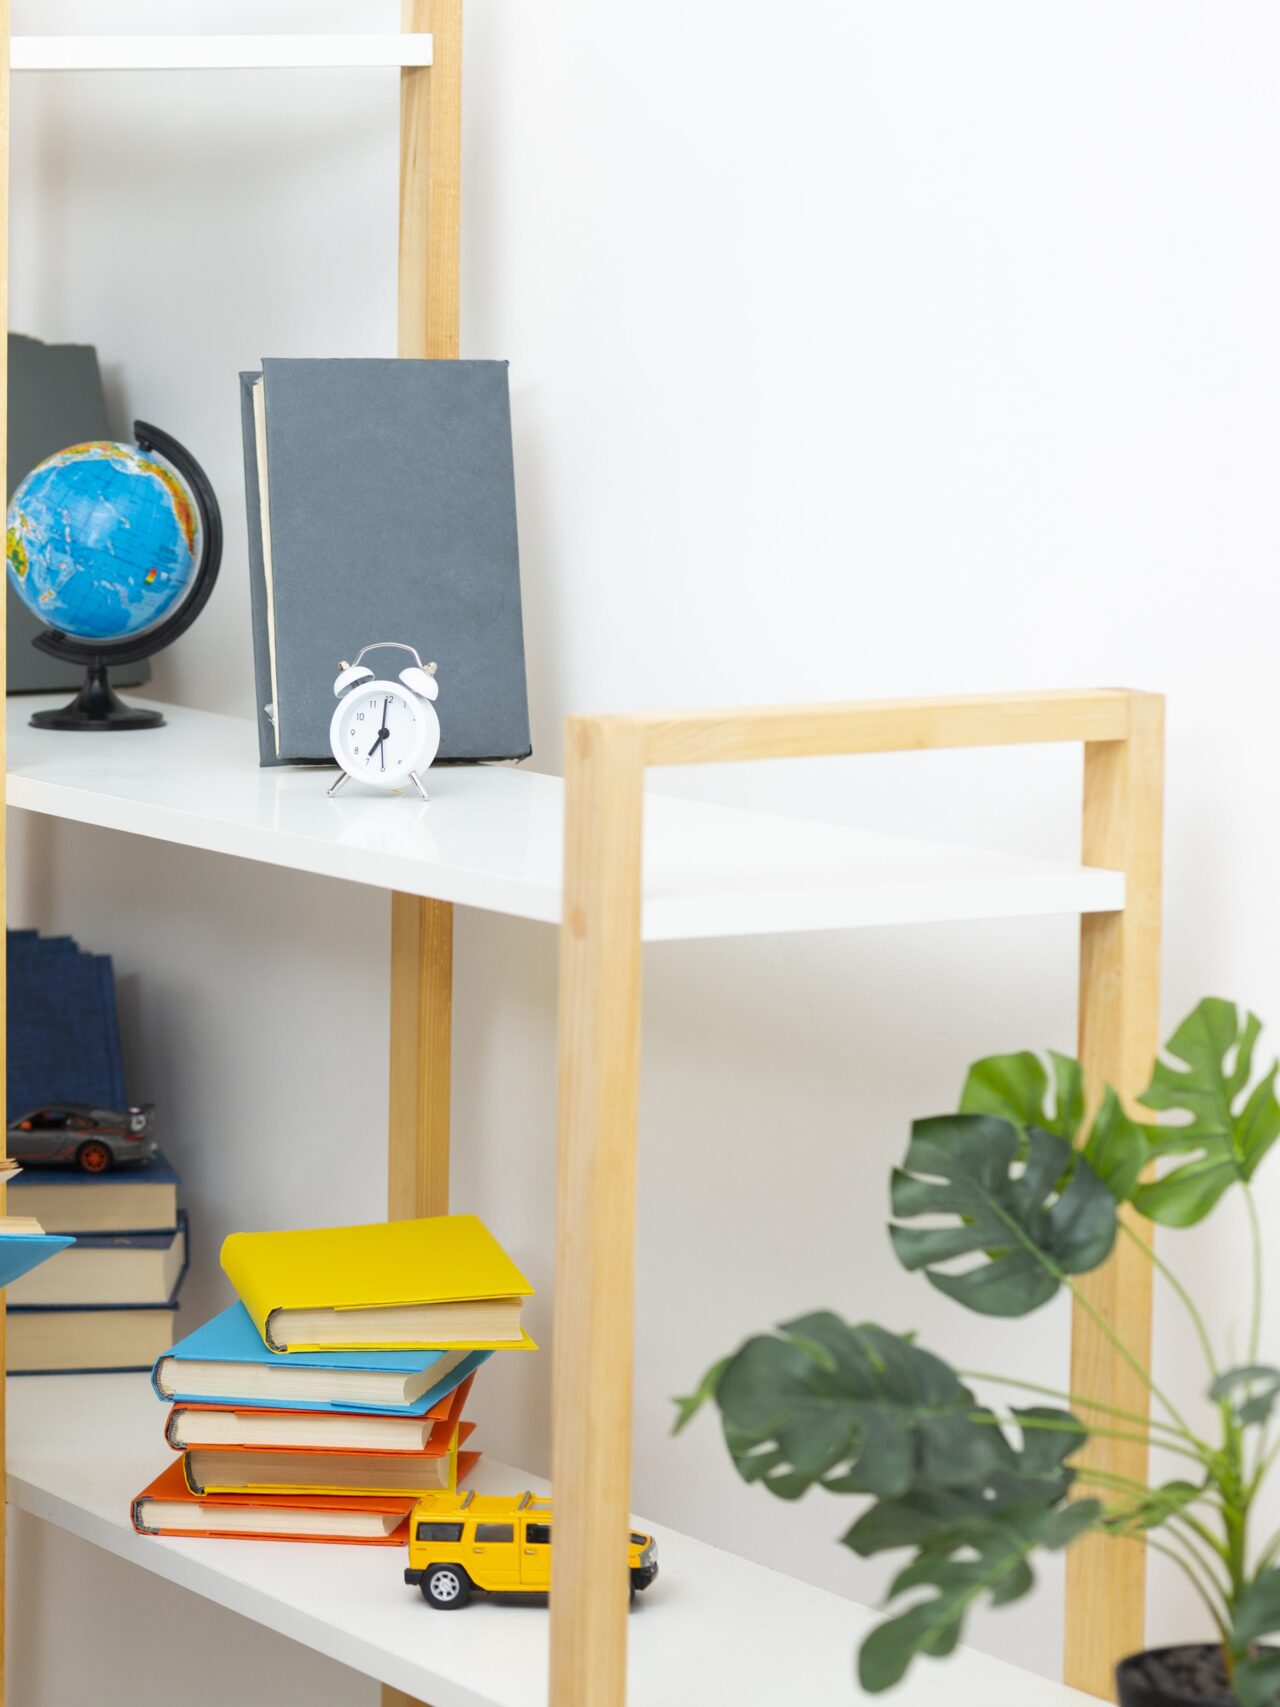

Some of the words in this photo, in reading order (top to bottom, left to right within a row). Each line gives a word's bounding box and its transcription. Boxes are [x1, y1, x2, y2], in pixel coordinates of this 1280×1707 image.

[369, 700, 377, 708] 11
[403, 701, 407, 709] 1
[356, 713, 365, 721] 10
[353, 747, 359, 755] 8
[365, 758, 370, 766] 7
